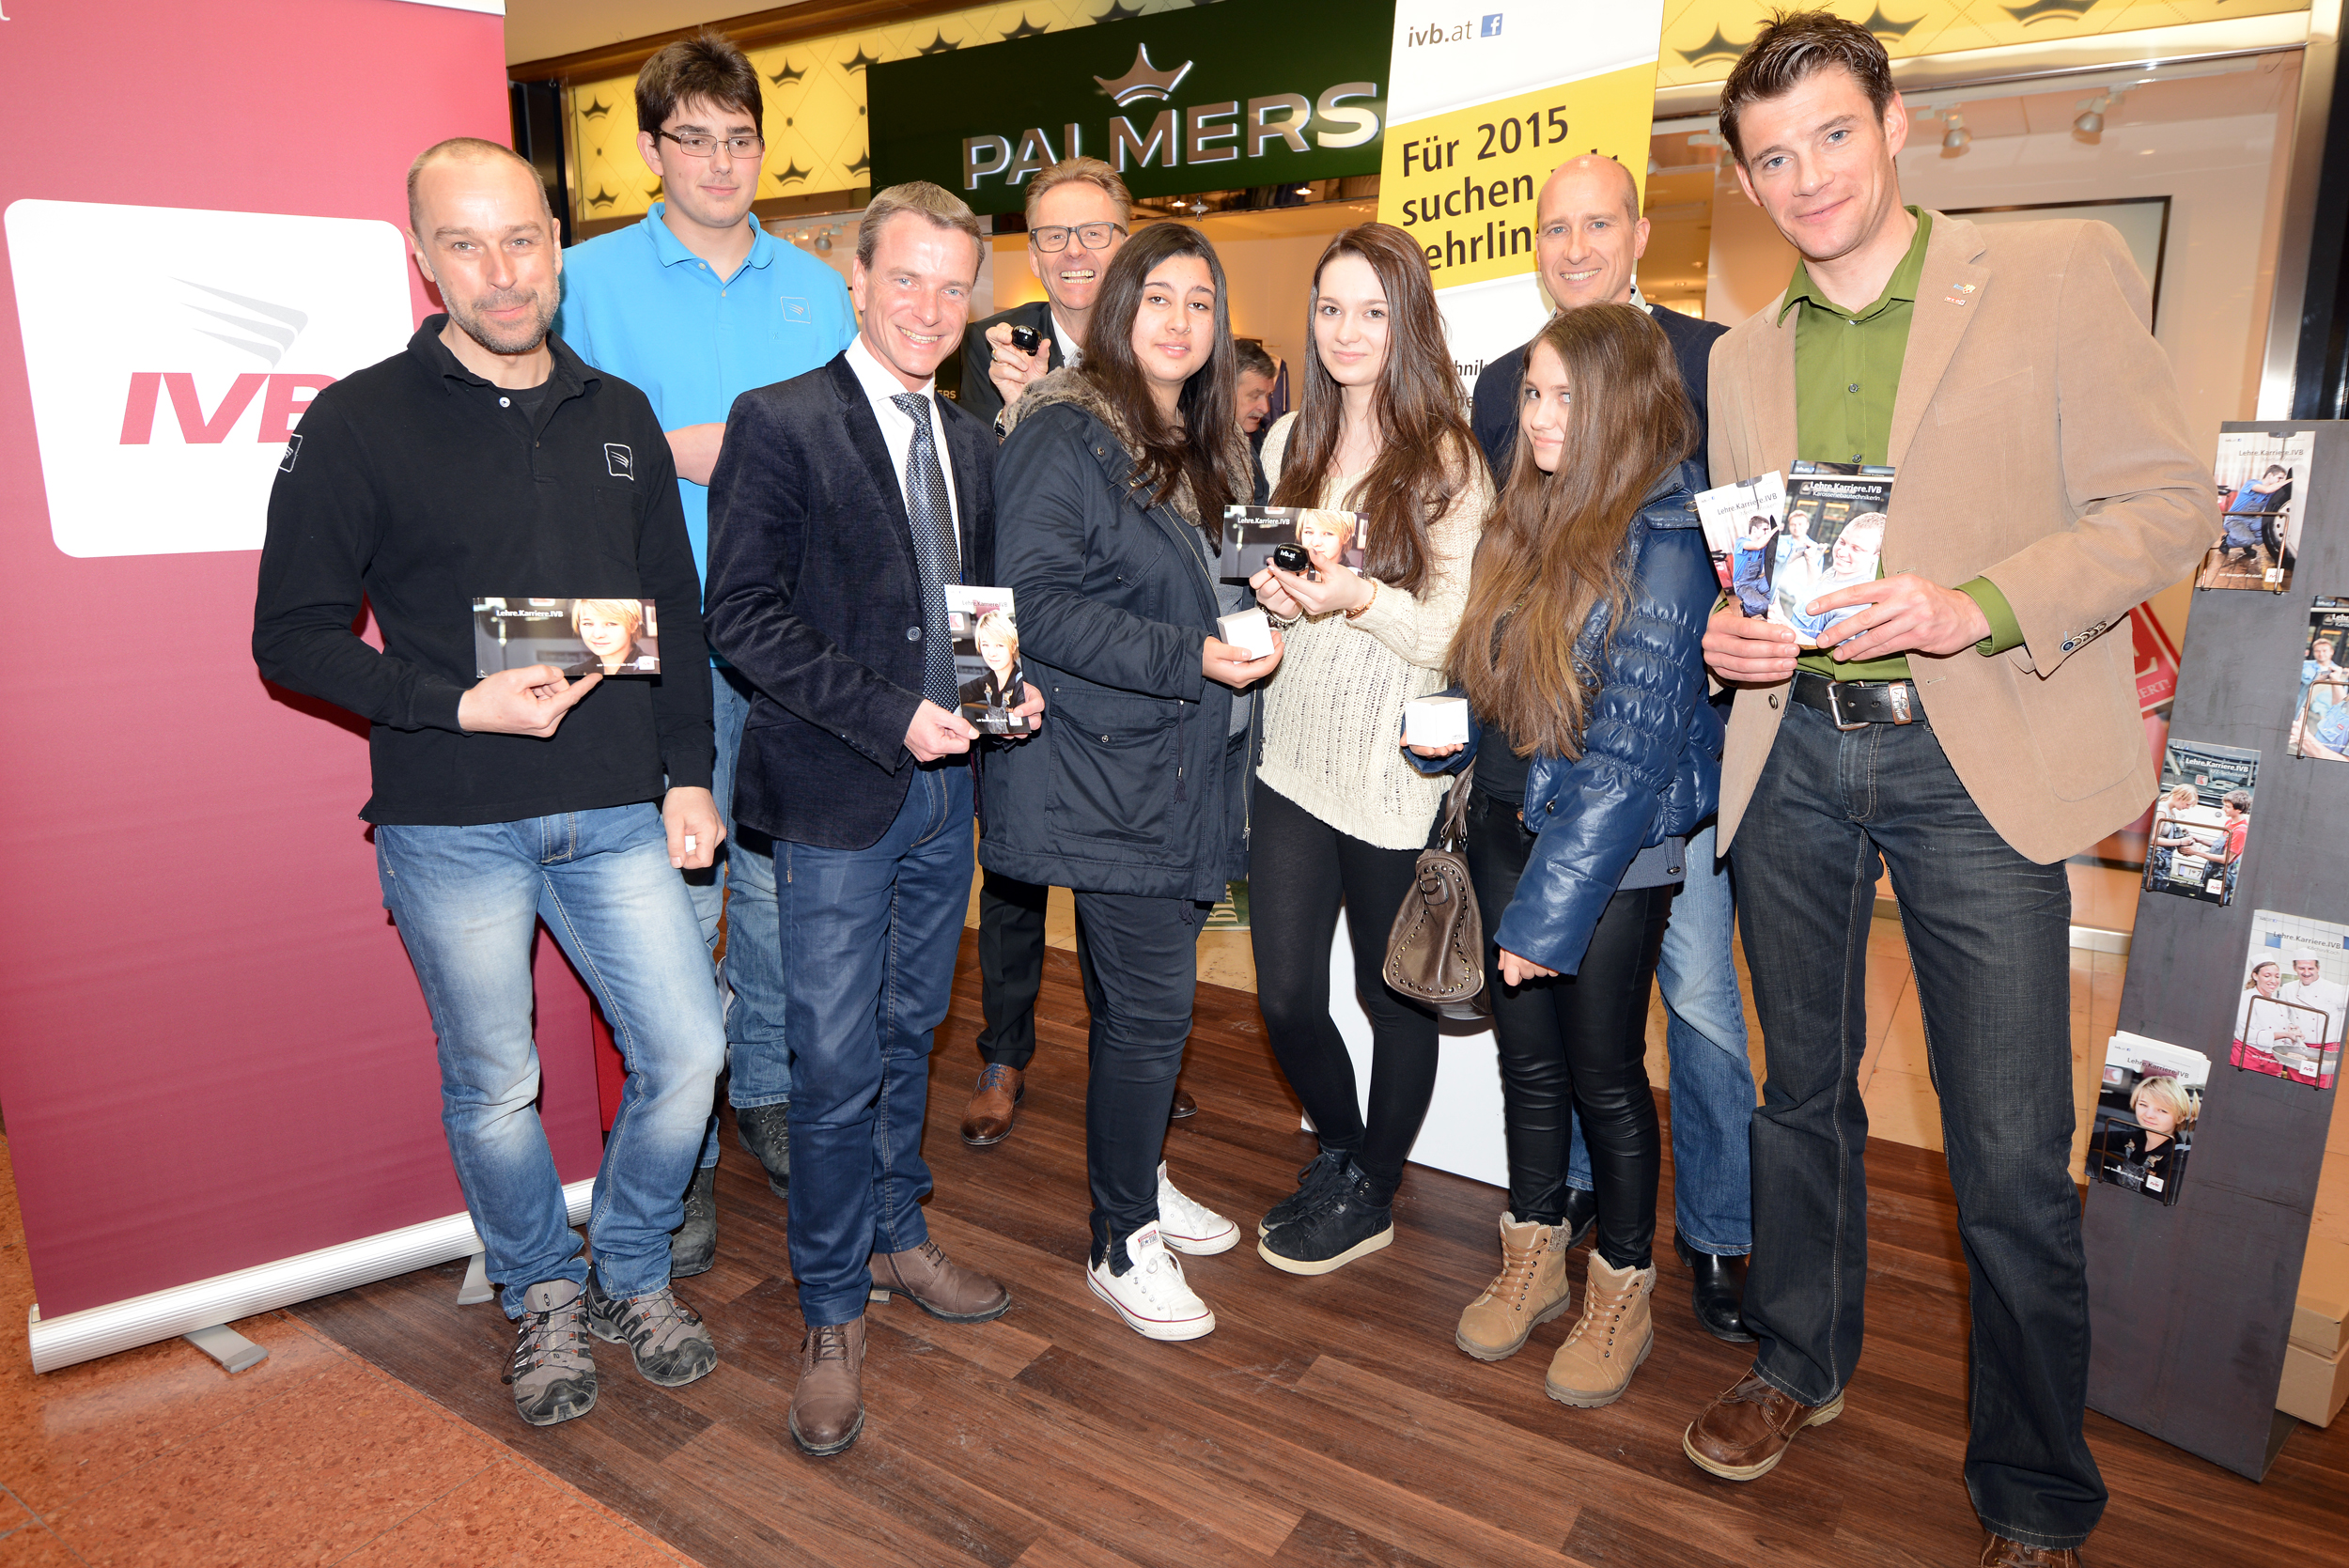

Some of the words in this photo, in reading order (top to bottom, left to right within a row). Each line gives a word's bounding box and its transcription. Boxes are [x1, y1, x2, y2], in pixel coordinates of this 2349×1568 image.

[1408, 21, 1472, 47] ivb.at
[962, 82, 1379, 191] PALMERS
[1403, 134, 1460, 178] Für
[1477, 105, 1568, 161] 2015
[1402, 173, 1534, 226] suchen
[1425, 220, 1539, 272] ehrlin
[119, 372, 339, 444] IVB
[1810, 481, 1883, 494] Lehre.Karriere.IVB
[1717, 492, 1778, 516] Lehre.Karriere.IVB
[1237, 517, 1290, 525] Lehre.Karriere.IVB
[961, 599, 1008, 608] Lehre.Karriere.IVB
[2186, 757, 2249, 772] Lehre.Karriere.IVB
[2273, 931, 2341, 950] Lehre.Karriere.IVB
[2126, 1057, 2190, 1079] Lehre.Karriere.IVB
